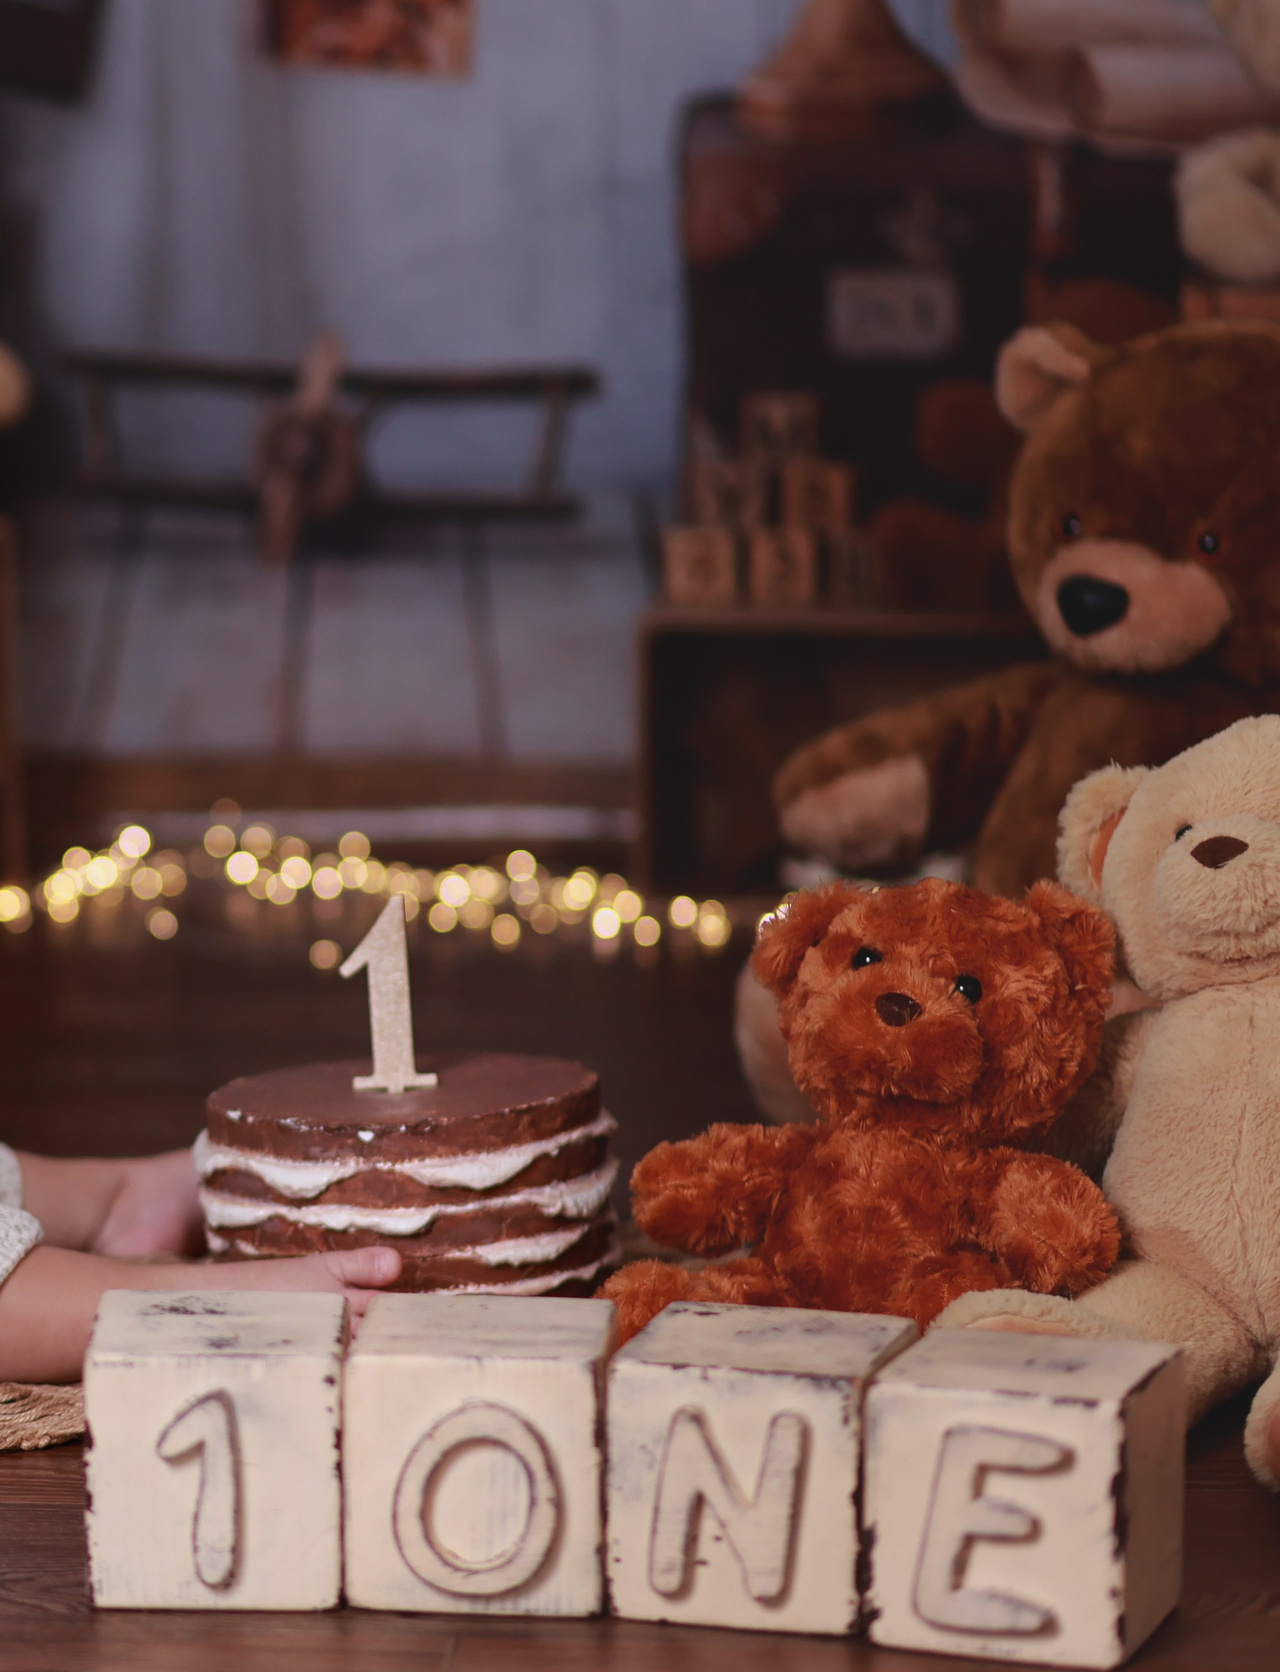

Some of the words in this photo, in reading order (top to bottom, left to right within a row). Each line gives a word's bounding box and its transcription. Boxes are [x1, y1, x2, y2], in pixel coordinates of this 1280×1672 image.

[339, 892, 438, 1093] 1
[156, 1388, 243, 1591] 1
[392, 1400, 1077, 1638] ONE
